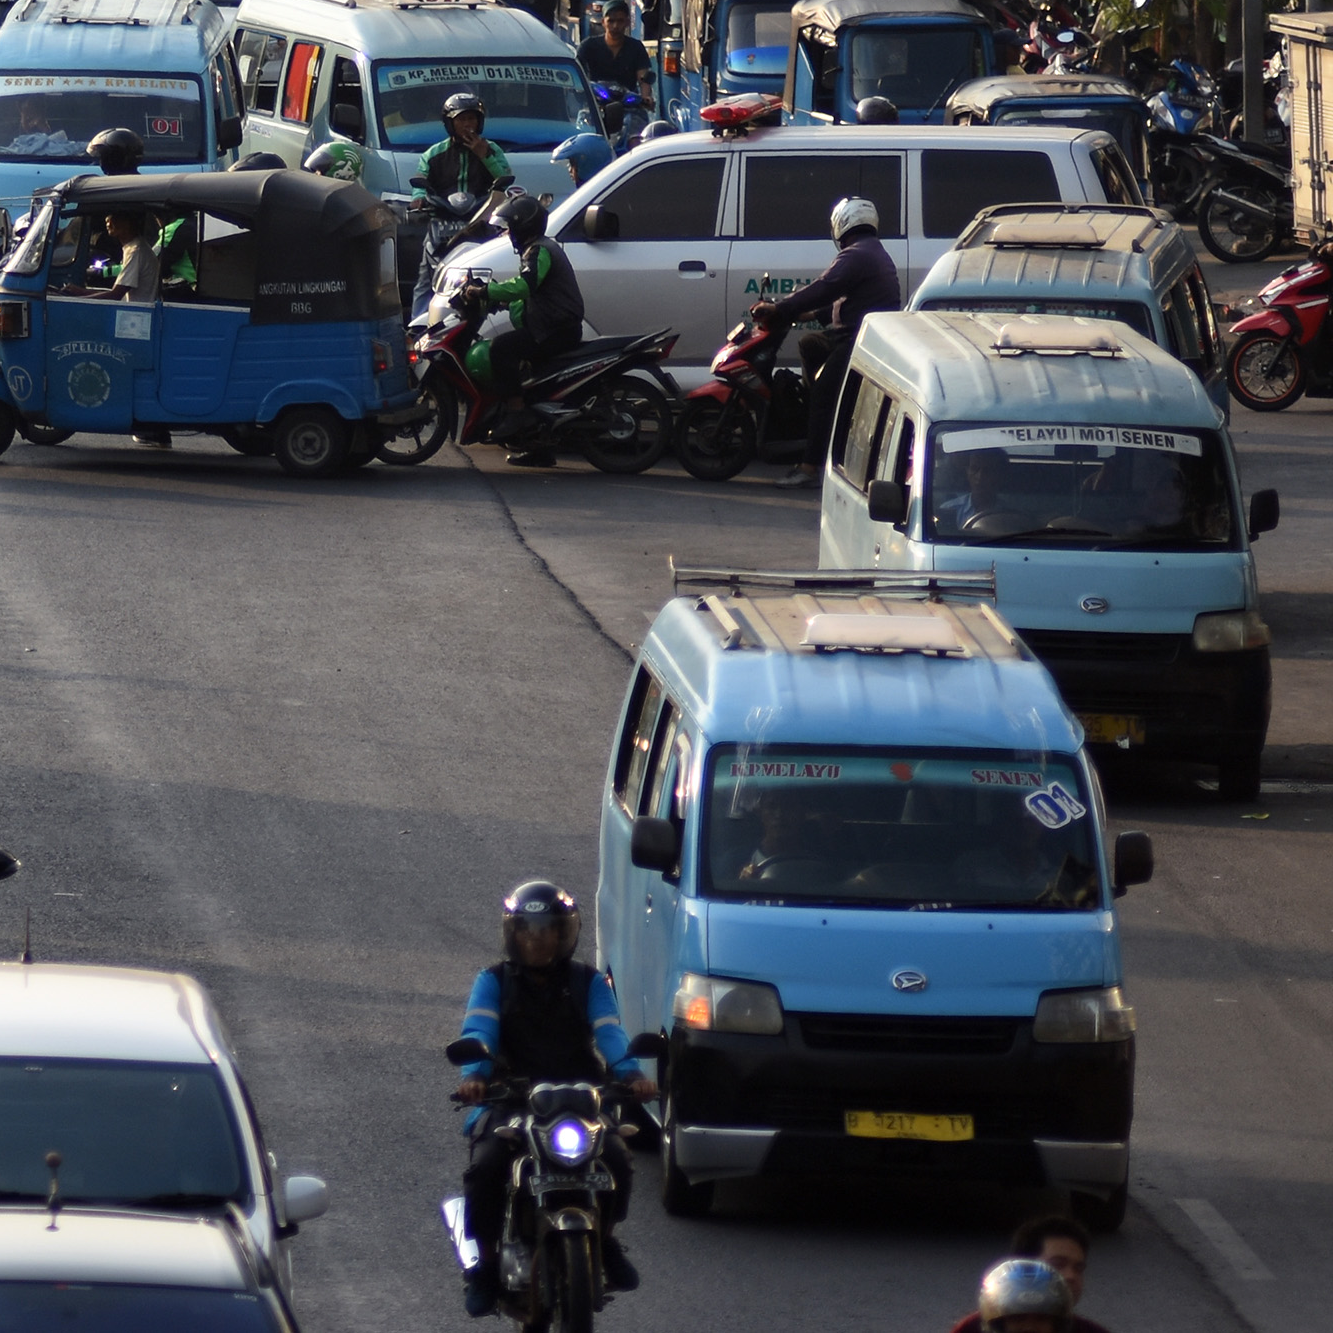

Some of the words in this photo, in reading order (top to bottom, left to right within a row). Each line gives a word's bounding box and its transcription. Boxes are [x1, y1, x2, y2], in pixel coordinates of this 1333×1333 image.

[431, 66, 479, 77] MELAYU
[487, 67, 514, 79] 01A
[517, 66, 555, 78] SENEN
[4, 76, 55, 89] SENEN
[152, 118, 179, 135] 01
[259, 281, 296, 294] ANGKUTAN
[298, 280, 347, 293] LINGKUNGAN
[71, 343, 112, 355] PELITA
[1000, 427, 1068, 446] MELAYU
[1078, 430, 1115, 445] M01
[1121, 432, 1175, 449] SENEN
[971, 770, 1042, 786] SENEN
